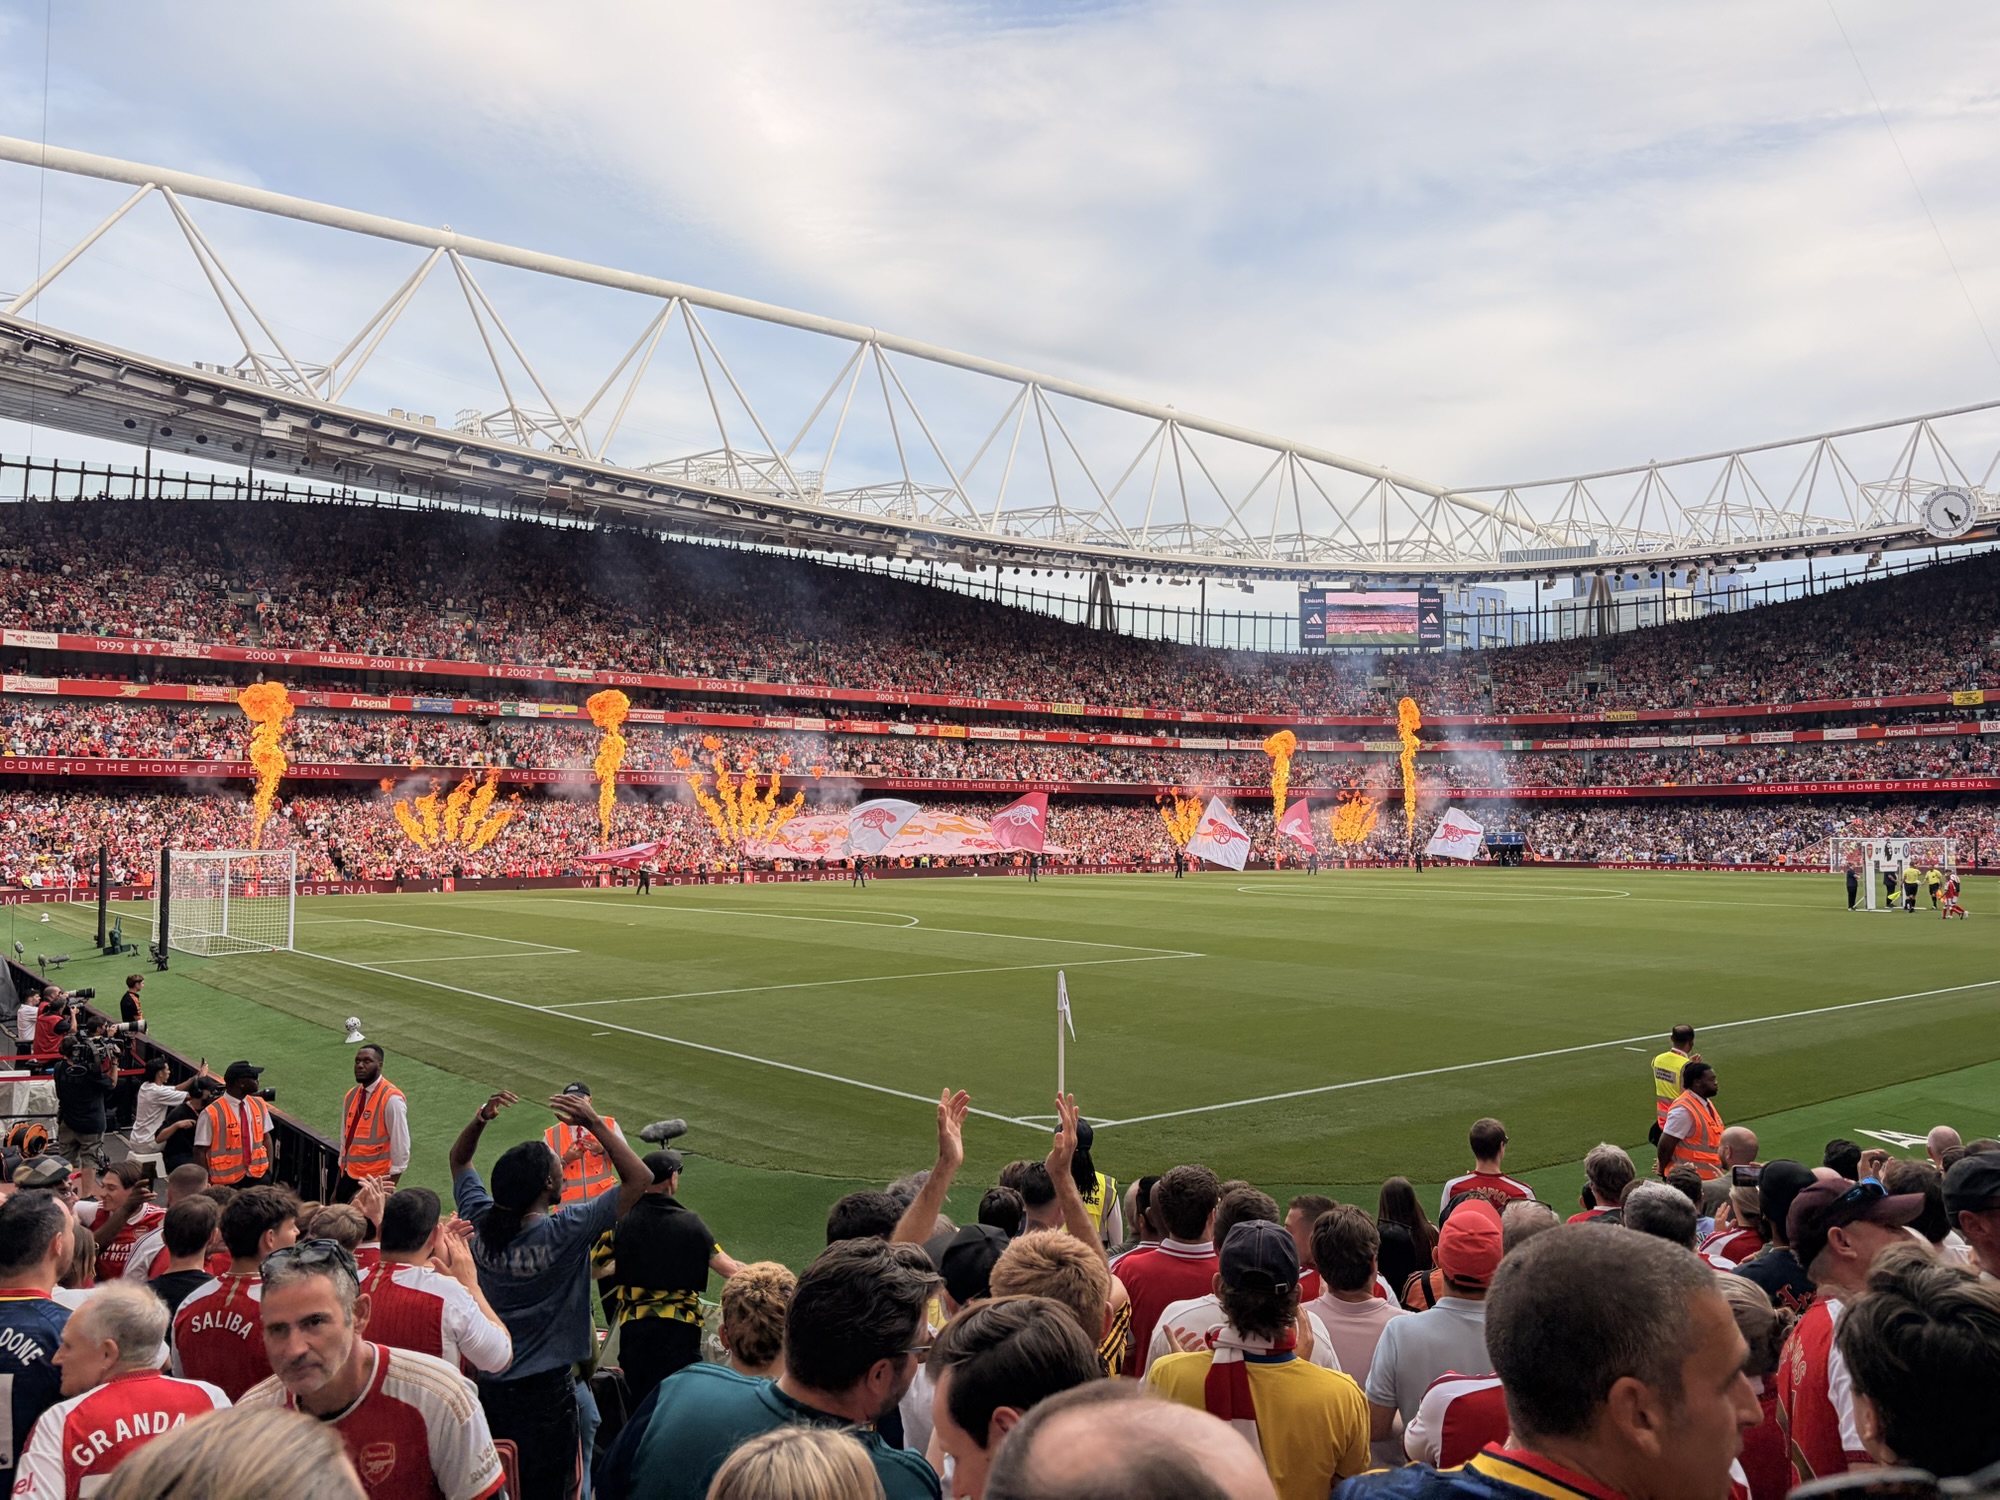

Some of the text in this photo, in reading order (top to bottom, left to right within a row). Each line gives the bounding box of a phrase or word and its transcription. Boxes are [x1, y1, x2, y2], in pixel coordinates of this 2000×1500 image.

[96, 640, 125, 651] 1999
[245, 651, 276, 661] 2000
[319, 655, 364, 665] MALAYSIA
[369, 659, 395, 669] 2001
[507, 668, 532, 677] 2002
[619, 675, 642, 684] 2003
[706, 681, 728, 690] 2004
[795, 688, 815, 696] 2005
[876, 693, 894, 701] 2006
[351, 697, 391, 709] Arsenal
[948, 698, 964, 706] 2007
[1851, 700, 1871, 708] 2018
[1023, 703, 1039, 711] 2008
[1087, 707, 1101, 715] 2009
[1606, 713, 1637, 721] MALDIVES
[1673, 710, 1690, 718] 2016
[764, 718, 792, 728] Arsenal
[971, 728, 993, 737] Arsenal
[1000, 729, 1020, 738] Liberia
[1024, 731, 1047, 740] Arsenal
[1885, 727, 1916, 737] Arsenal
[1542, 741, 1568, 749] Arsenal
[1574, 740, 1594, 748] HONG
[0, 760, 55, 771] COME
[65, 762, 86, 771] TO
[96, 763, 129, 772] THE
[139, 764, 188, 773] HOME
[197, 765, 218, 773] OF
[289, 767, 340, 776] SENAL
[510, 772, 575, 781] WELCOME
[631, 774, 665, 782] HOME
[887, 780, 933, 788] WELCOME
[952, 781, 968, 789] THE
[971, 782, 997, 790] HOME
[1033, 783, 1071, 791] ARSENAL
[1848, 783, 1881, 791] HOME
[1008, 868, 1058, 876] WELOME
[723, 875, 760, 884] HOE
[767, 874, 784, 883] OF
[819, 872, 877, 881] ARSEAL
[42, 893, 66, 903] TO
[191, 1310, 254, 1340] SALIBA
